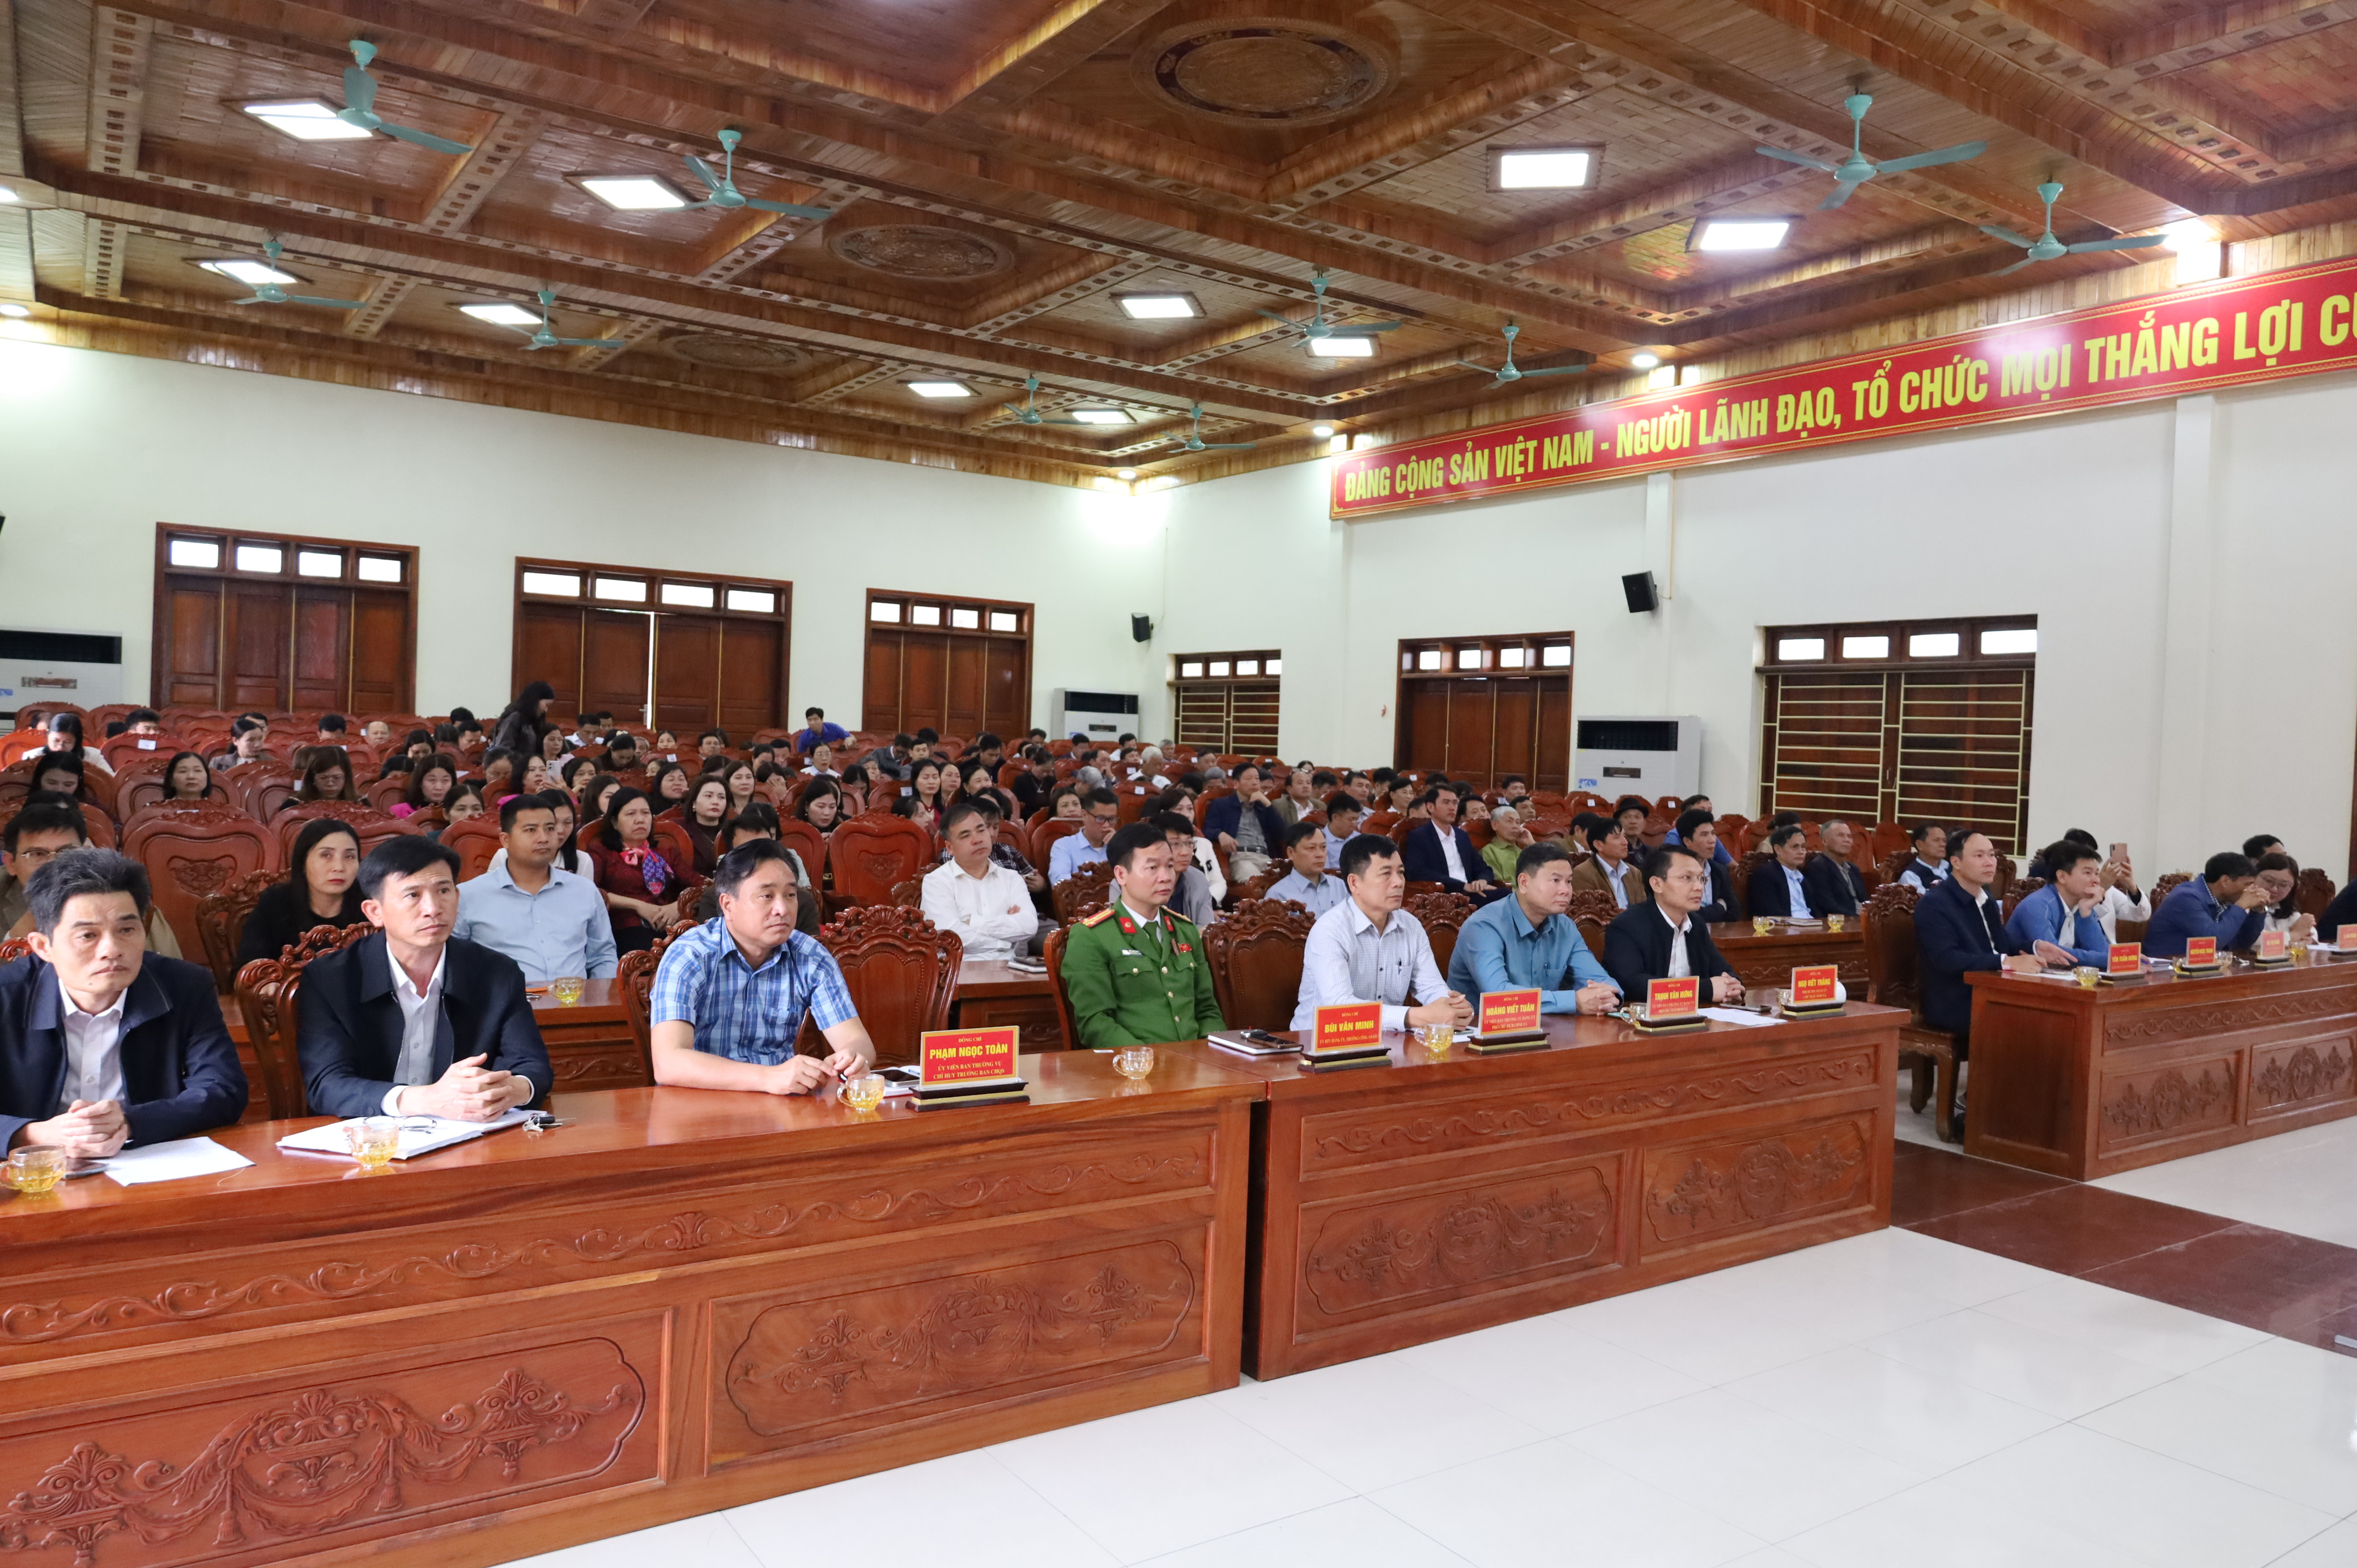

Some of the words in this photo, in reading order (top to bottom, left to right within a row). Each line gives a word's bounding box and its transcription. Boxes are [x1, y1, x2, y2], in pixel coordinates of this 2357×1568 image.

[1345, 461, 1391, 502] ĐẢNG
[1395, 455, 1444, 498] CỘNG
[1449, 441, 1490, 485] SẢN
[1495, 436, 1538, 482] VIỆT
[1542, 429, 1594, 471] NAM
[1616, 404, 1691, 459] NGƯỜI
[1699, 398, 1769, 446] LÃNH
[1776, 387, 1841, 438] ĐẠO,
[1852, 360, 1892, 421] TỔ
[1899, 355, 1989, 414] CHỨC
[2000, 343, 2071, 400] MỌI
[2084, 310, 2220, 383] THẮNG
[2233, 299, 2304, 366] LỢI
[2319, 292, 2357, 346] C
[1486, 1005, 1506, 1016] HOÀNG
[1507, 1002, 1519, 1014] VIẾT
[1325, 1022, 1337, 1033] BÙI
[1339, 1021, 1354, 1032] VĂN
[1355, 1020, 1374, 1030] MINH
[930, 1047, 956, 1060] PHẠM
[959, 1045, 983, 1058] NGỌC
[985, 1042, 1008, 1055] TOÀN
